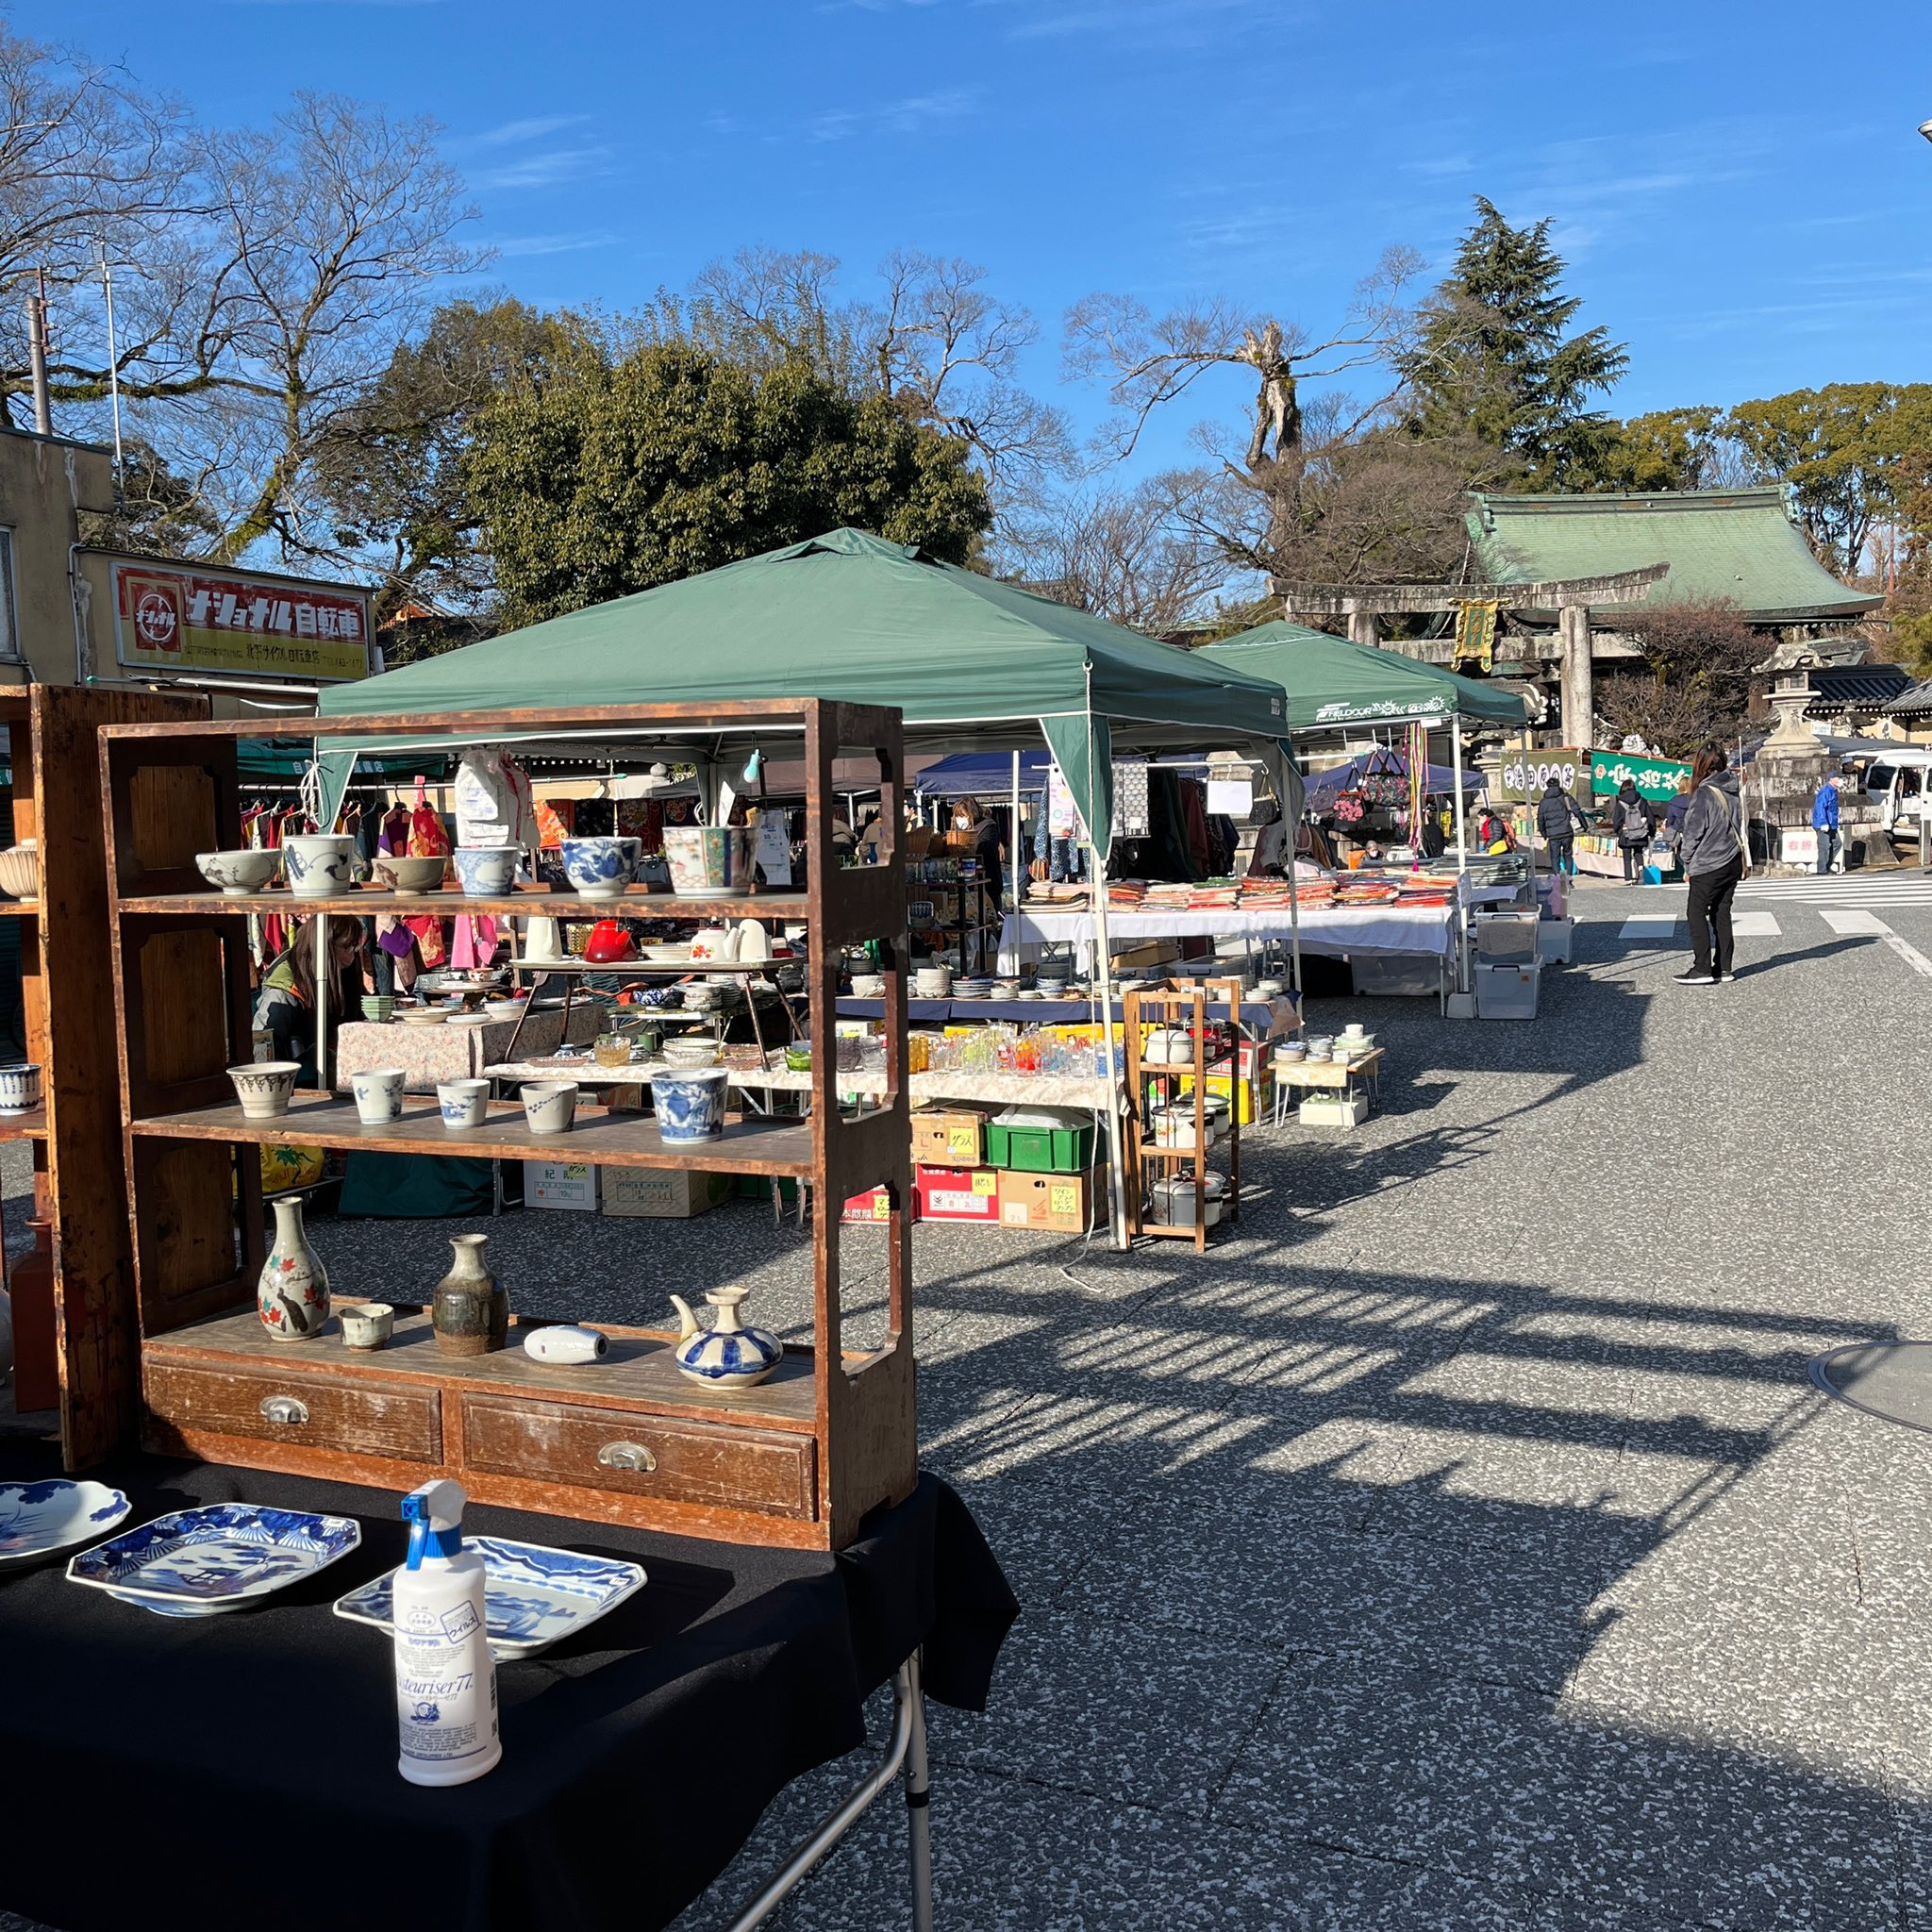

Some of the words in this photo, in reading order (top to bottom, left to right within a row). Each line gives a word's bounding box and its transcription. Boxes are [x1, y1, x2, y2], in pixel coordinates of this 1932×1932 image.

[189, 589, 358, 638] ナショナル自転車
